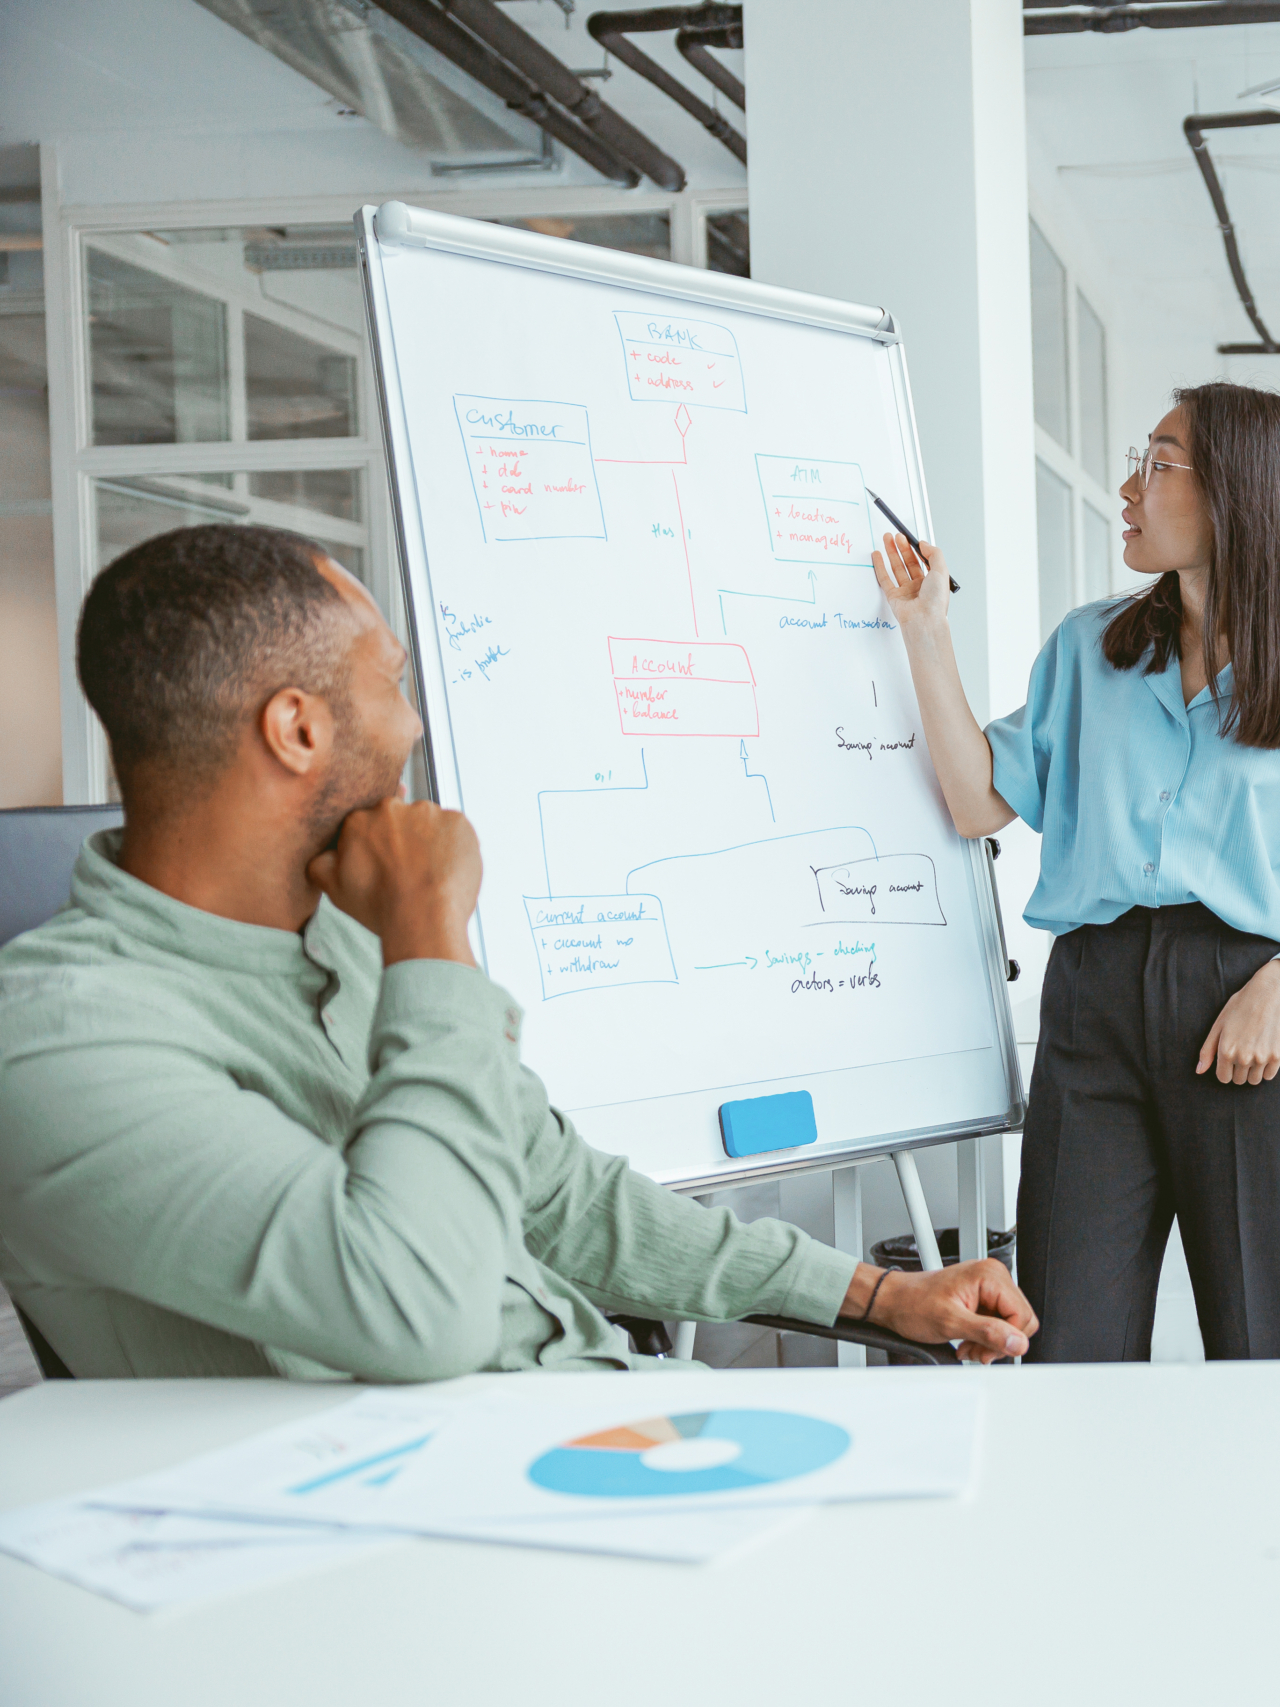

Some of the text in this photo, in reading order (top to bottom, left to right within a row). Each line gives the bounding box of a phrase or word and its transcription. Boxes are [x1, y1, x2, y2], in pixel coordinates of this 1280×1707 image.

[647, 322, 703, 350] BANK
[647, 351, 682, 365] code
[790, 464, 822, 483] ATM
[787, 504, 840, 524] location
[632, 700, 679, 720] balance
[560, 955, 620, 974] withdraw
